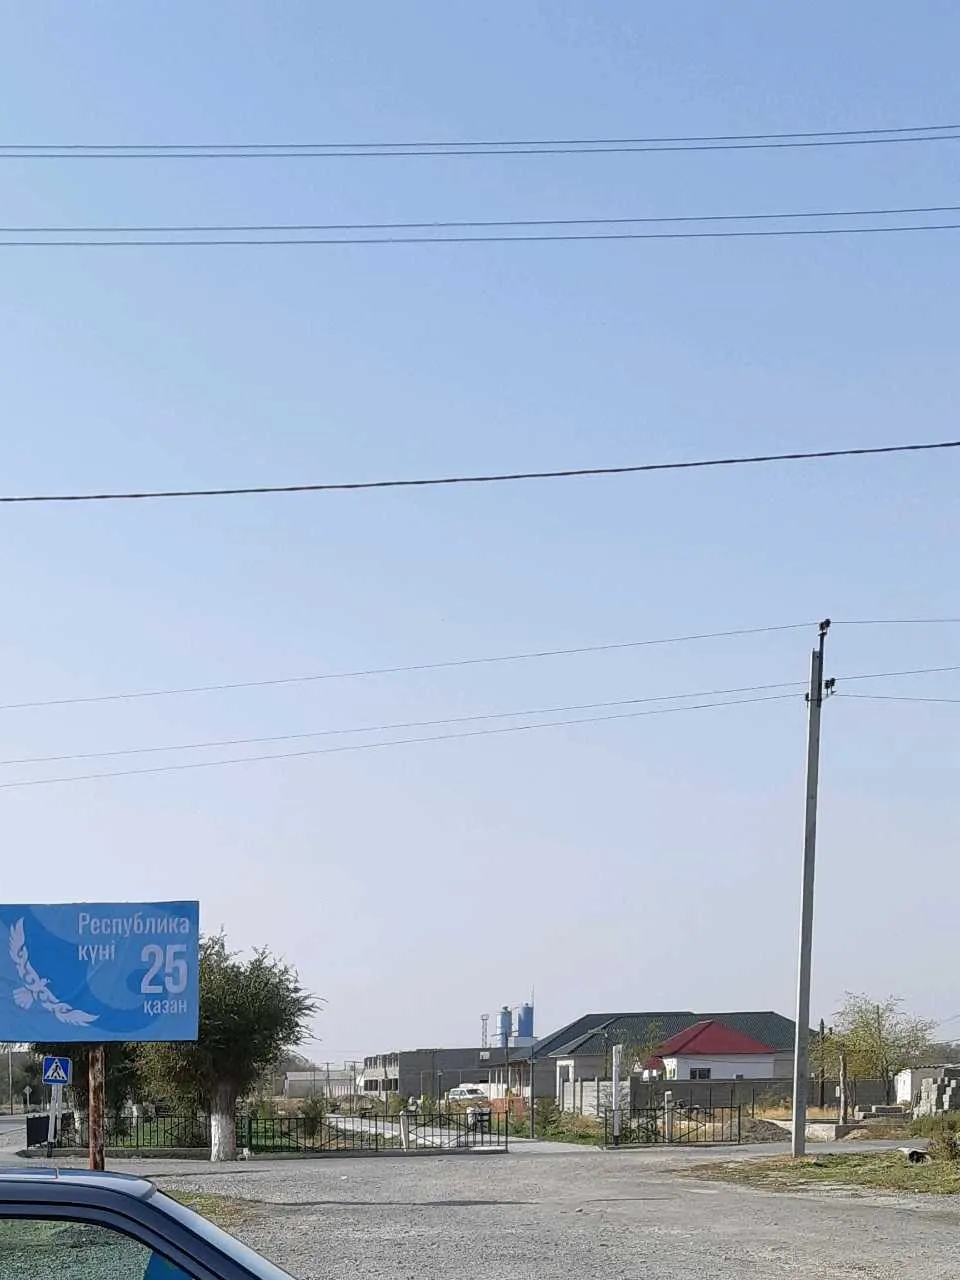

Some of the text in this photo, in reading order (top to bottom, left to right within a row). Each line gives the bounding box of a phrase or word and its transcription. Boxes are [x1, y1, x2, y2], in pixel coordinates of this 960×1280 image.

[78, 912, 190, 937] Республика
[78, 941, 115, 964] күні
[140, 944, 188, 994] 25
[143, 999, 187, 1016] қазан
